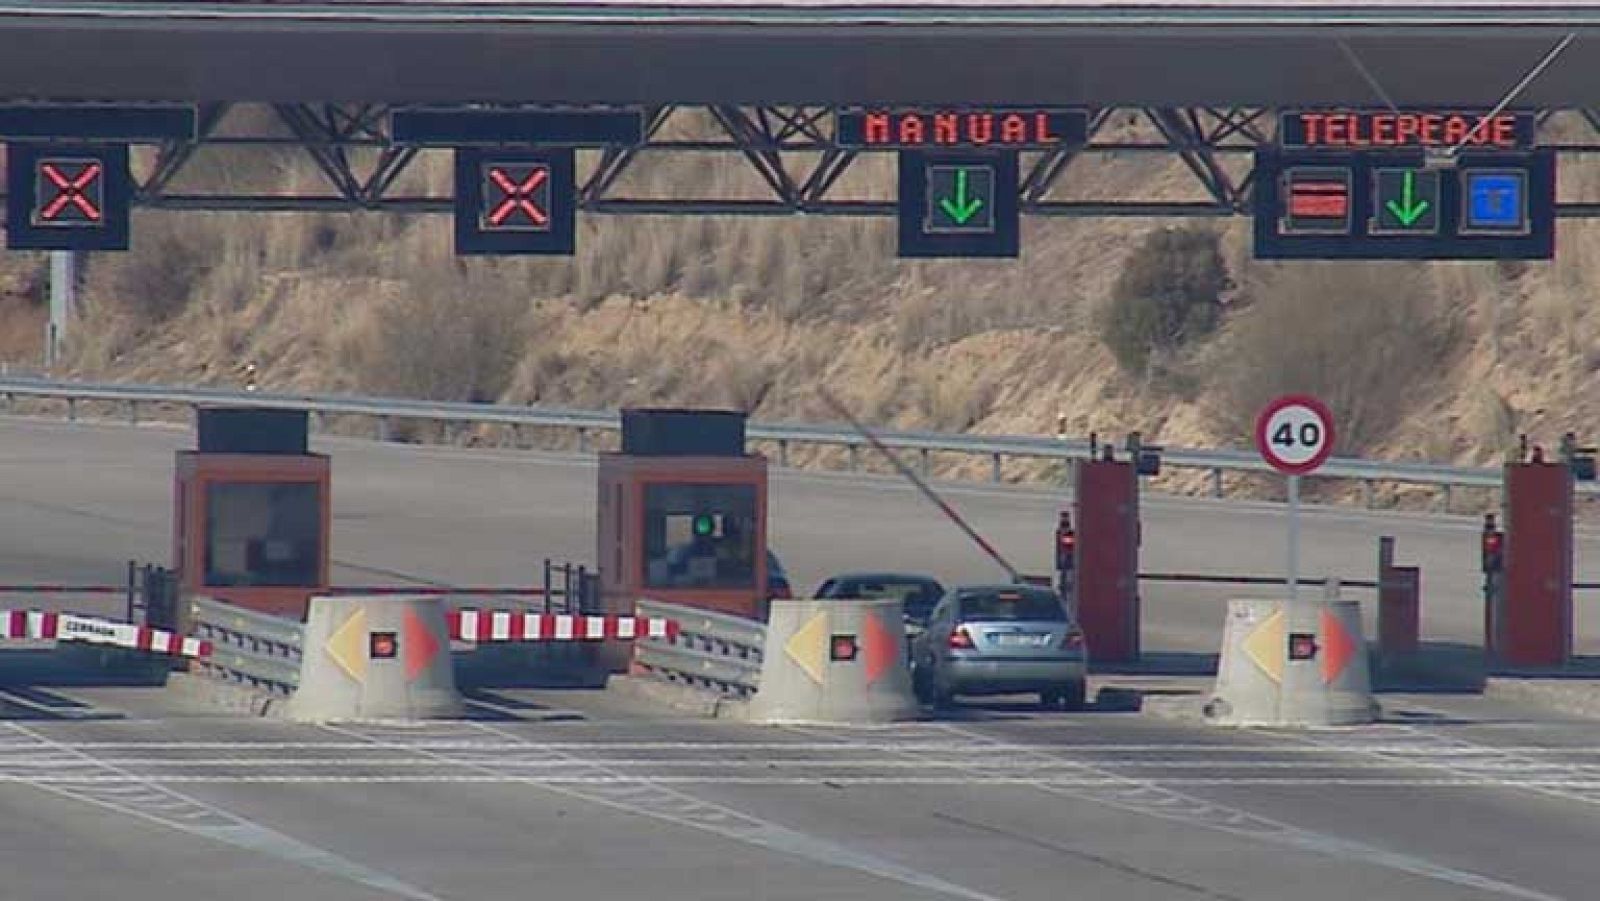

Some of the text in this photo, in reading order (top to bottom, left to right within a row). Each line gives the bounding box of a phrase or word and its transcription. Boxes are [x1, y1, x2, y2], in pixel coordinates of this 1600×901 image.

[865, 112, 1061, 144] MANUAL
[1301, 112, 1516, 145] TELEPEAJE
[1272, 422, 1320, 447] 40
